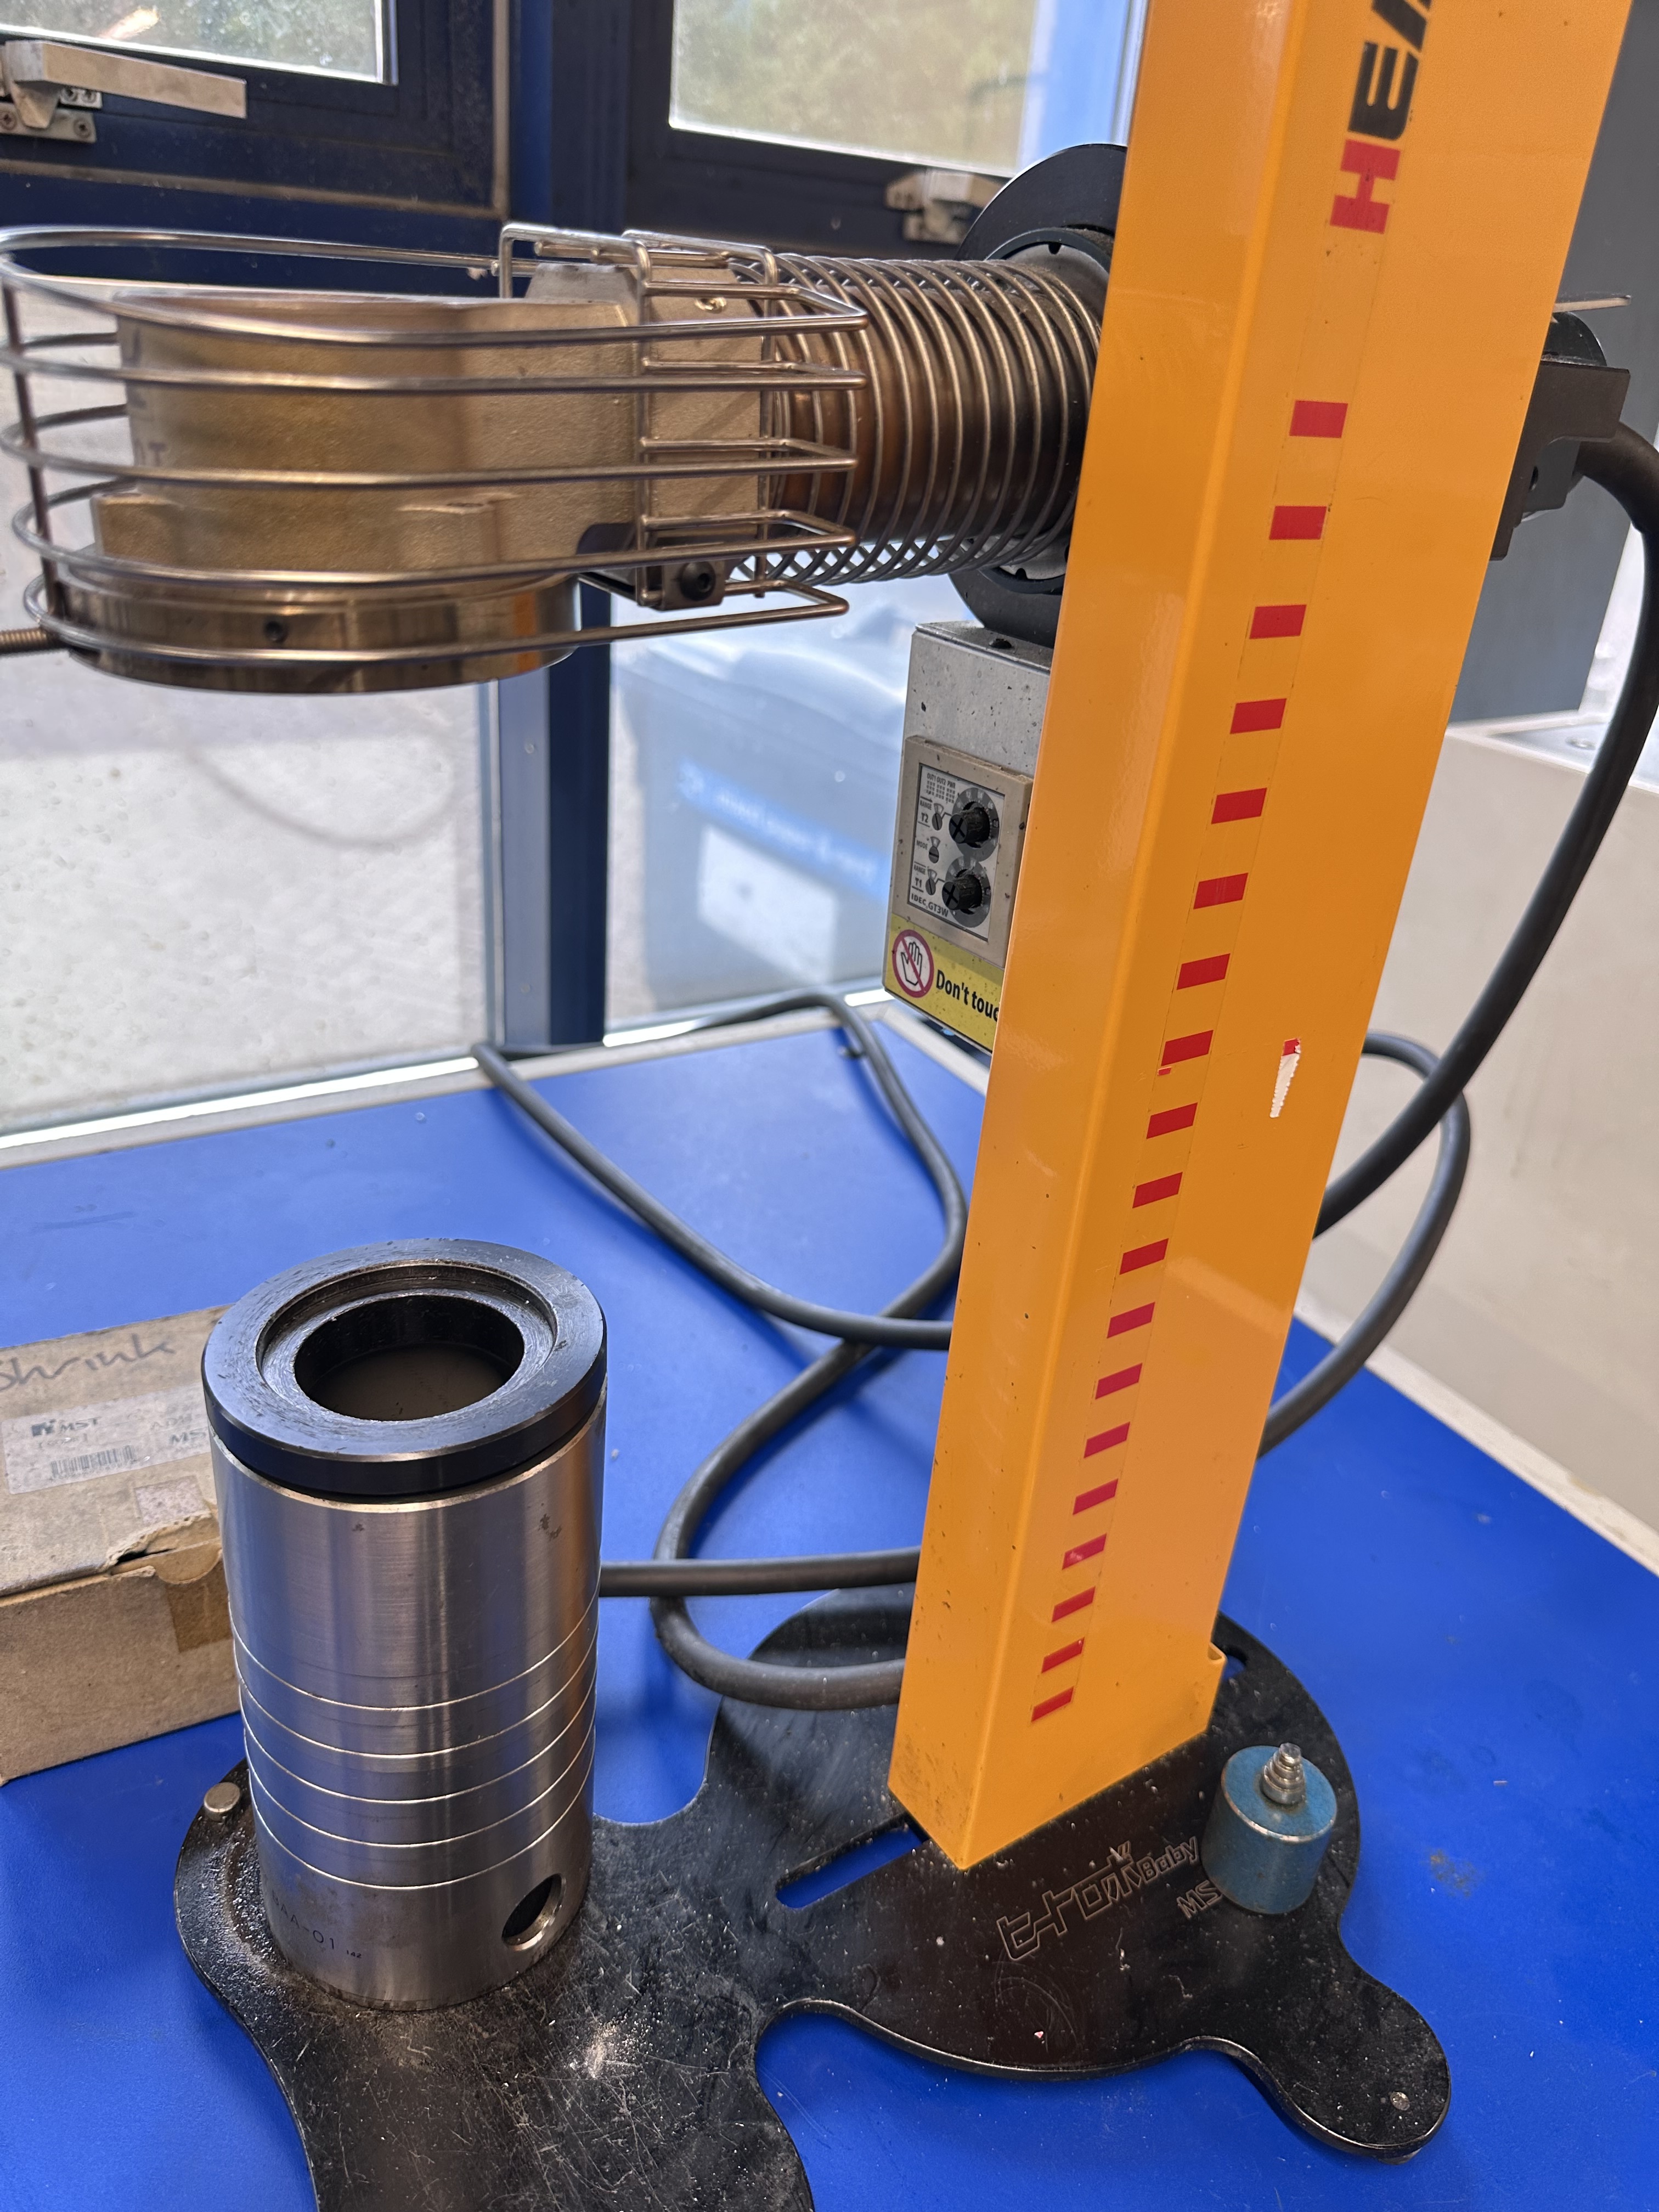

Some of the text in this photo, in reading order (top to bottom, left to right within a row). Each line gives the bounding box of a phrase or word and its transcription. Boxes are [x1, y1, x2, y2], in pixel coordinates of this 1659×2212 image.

[919, 800, 932, 810] RANGE
[921, 812, 929, 823] T2
[916, 840, 928, 850] MODE
[913, 864, 926, 875] RANGE
[915, 877, 922, 888] T1
[911, 893, 949, 918] IDEC GT3W
[936, 969, 969, 1006] Don't
[1137, 1836, 1198, 1884] Baby
